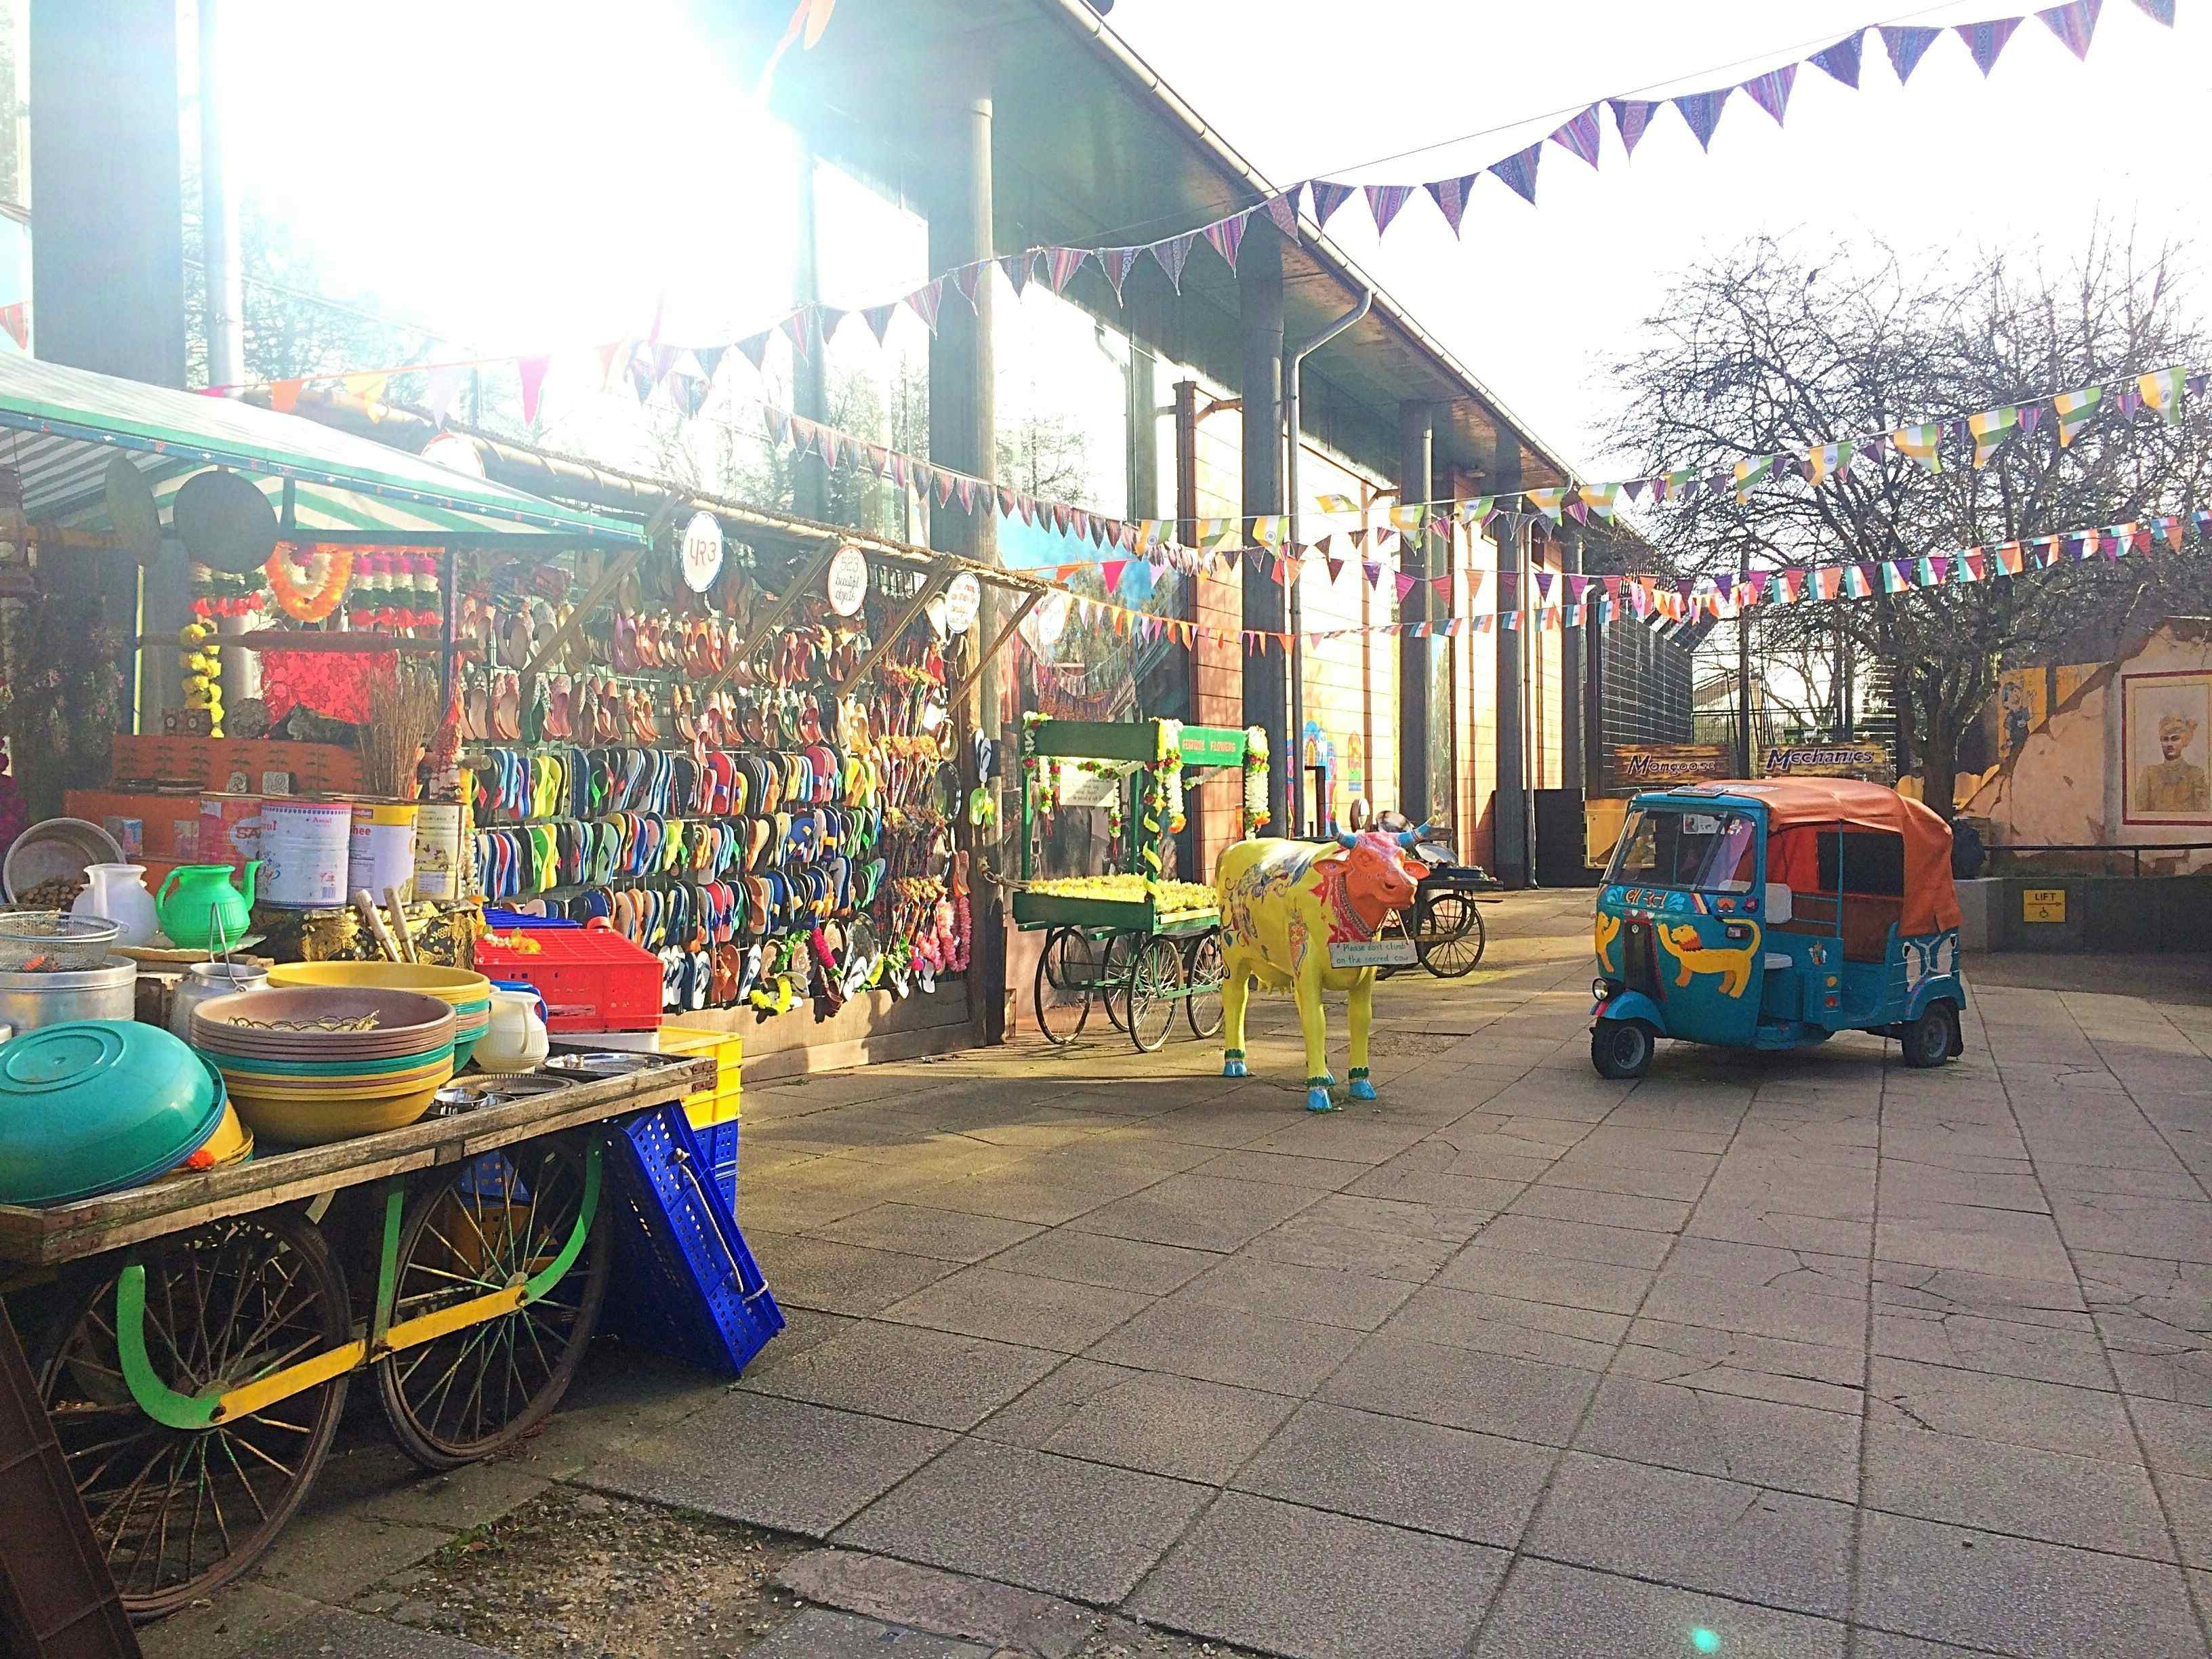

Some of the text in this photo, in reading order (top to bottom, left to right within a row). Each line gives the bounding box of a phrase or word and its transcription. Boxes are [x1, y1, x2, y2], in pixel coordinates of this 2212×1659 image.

[841, 556, 859, 572] 523
[1626, 748, 1875, 776] Mongoose Mechanics
[2034, 893, 2056, 901] LIFT
[1343, 943, 1366, 952] Please
[1386, 941, 1406, 950] climb
[1348, 955, 1361, 964] the
